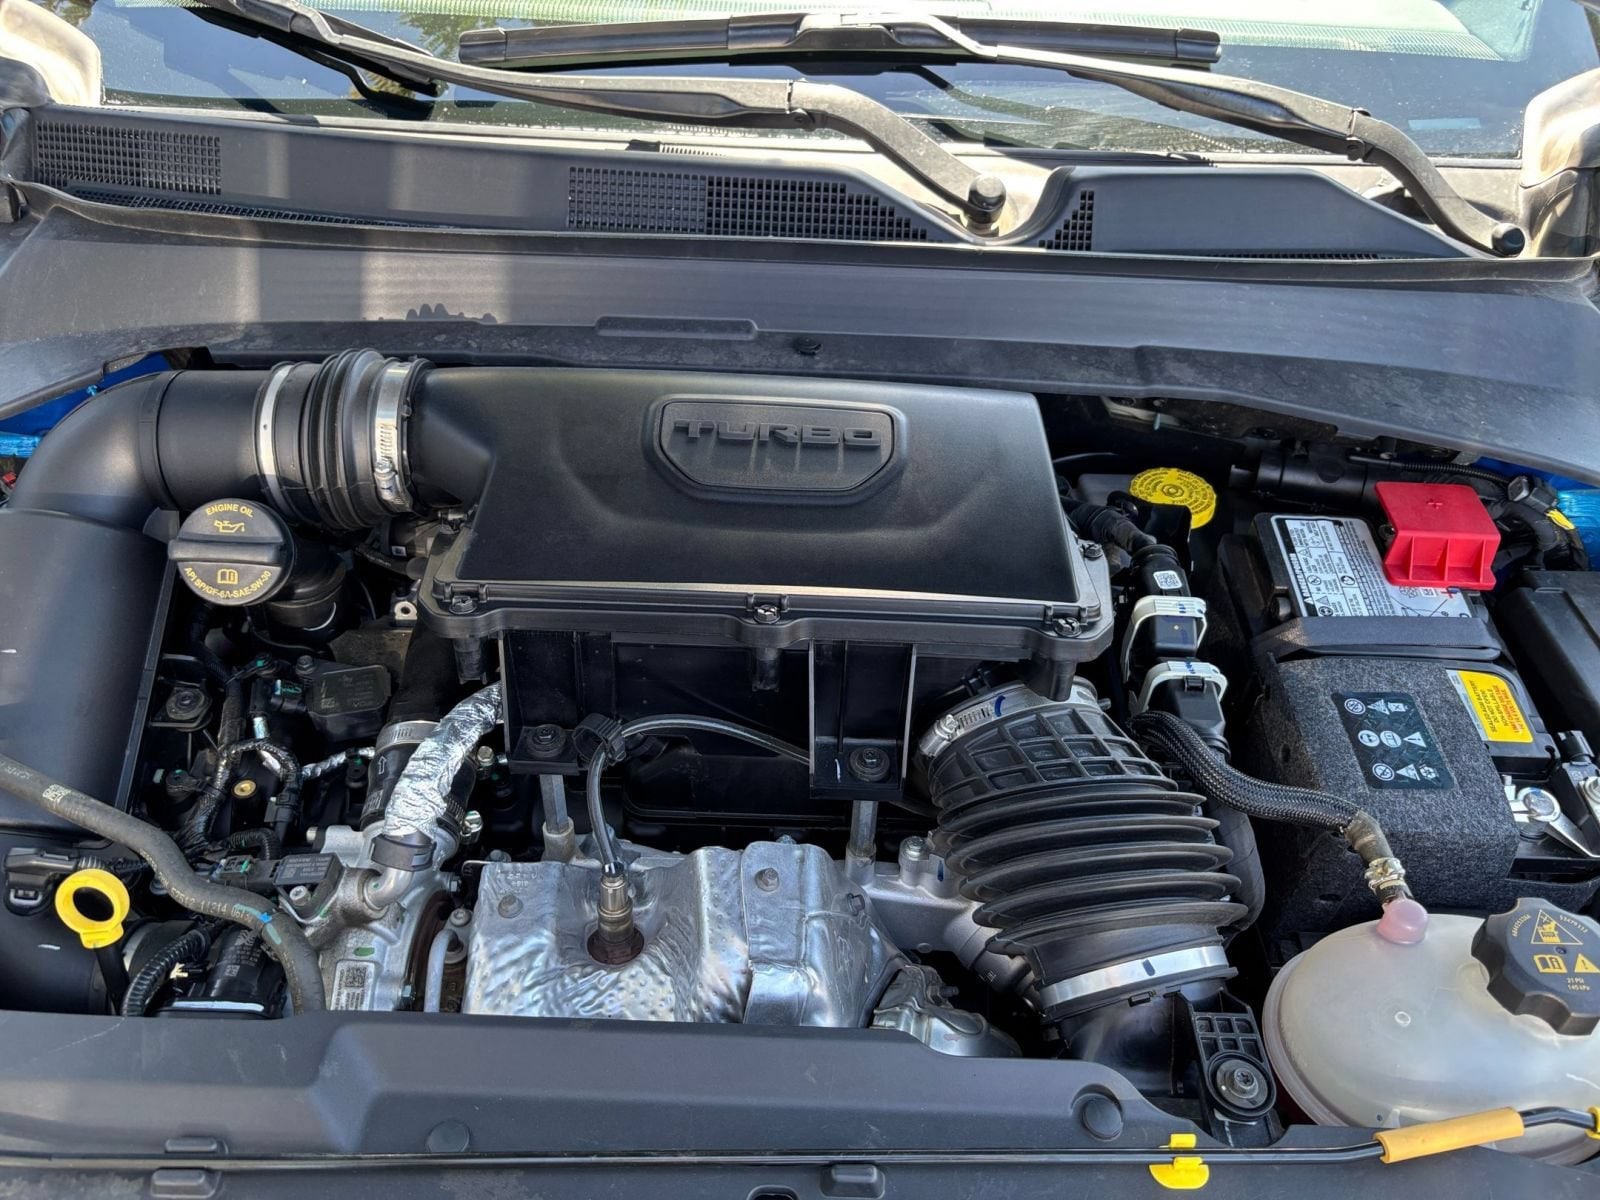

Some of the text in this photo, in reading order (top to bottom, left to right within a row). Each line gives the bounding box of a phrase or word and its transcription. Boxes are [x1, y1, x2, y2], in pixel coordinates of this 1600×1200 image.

[673, 418, 881, 448] TURBO
[205, 503, 254, 518] ENGINE OIL
[184, 567, 197, 582] API
